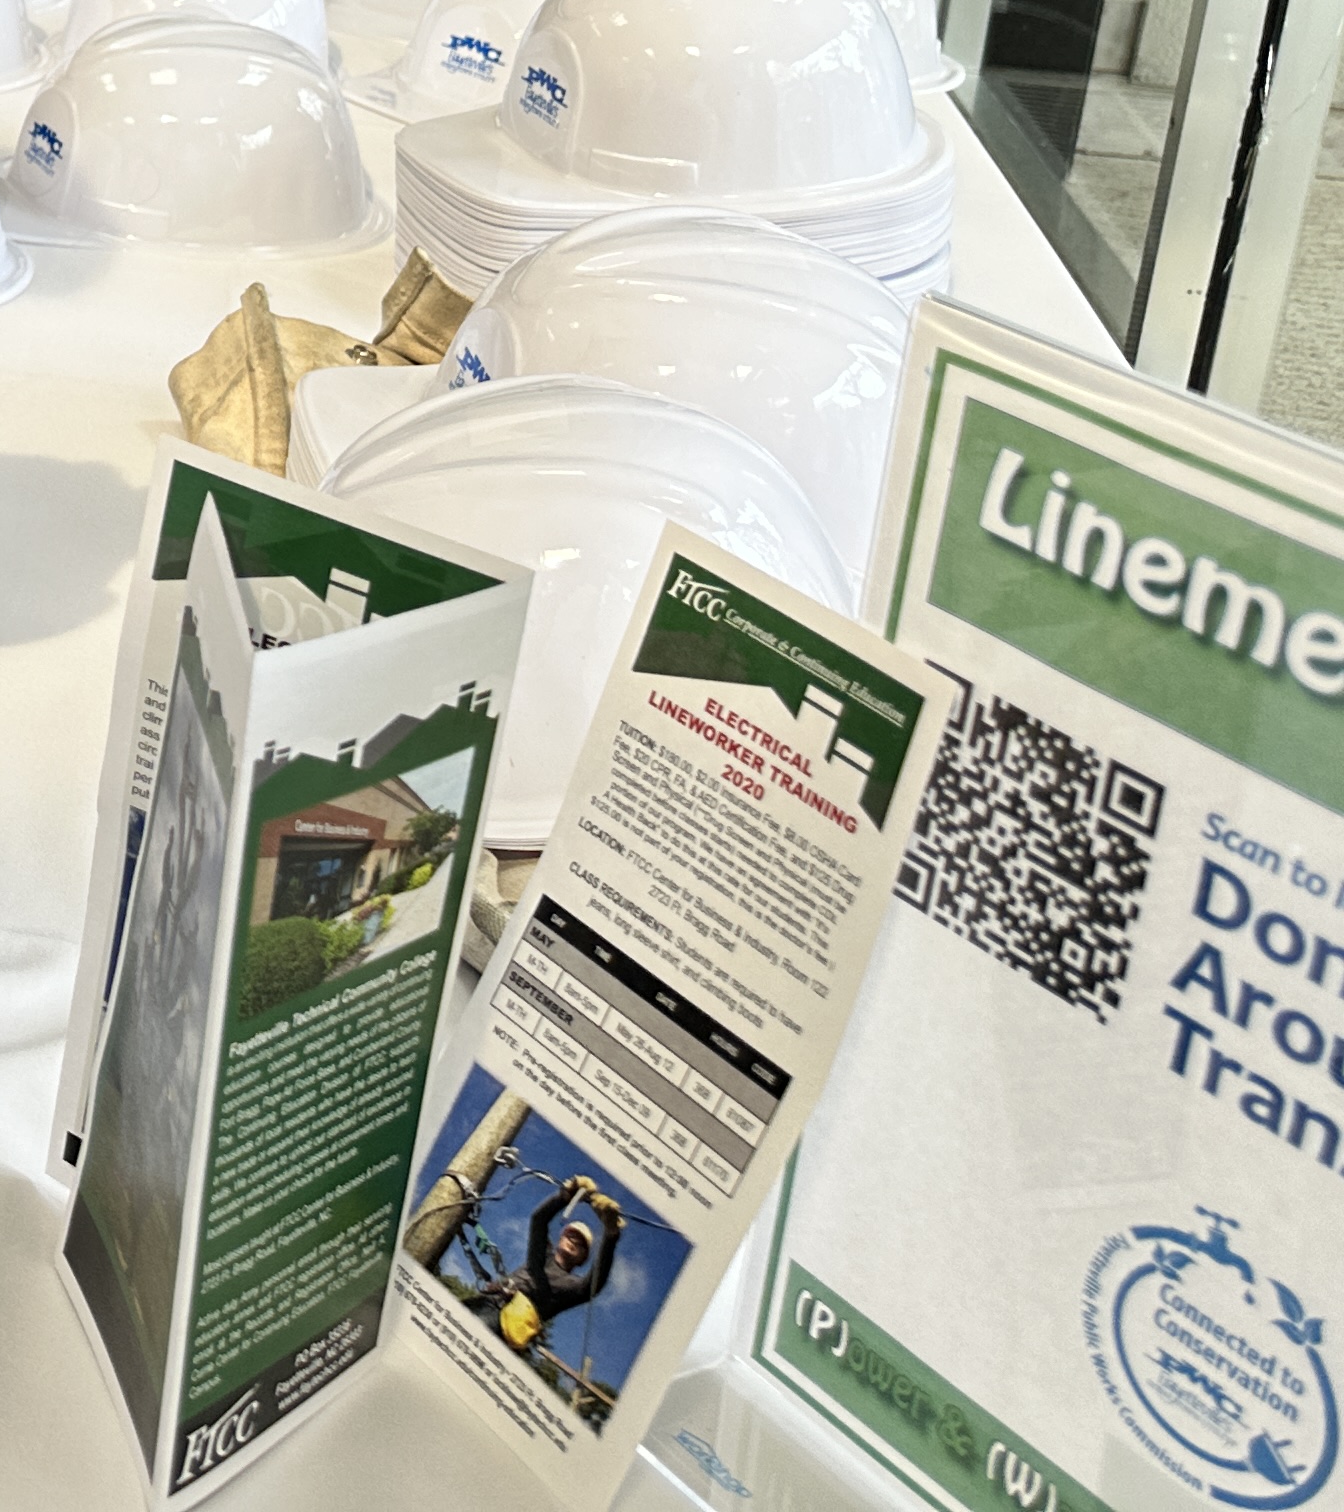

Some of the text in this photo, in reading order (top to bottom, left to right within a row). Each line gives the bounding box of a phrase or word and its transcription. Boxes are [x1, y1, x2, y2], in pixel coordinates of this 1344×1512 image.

[980, 447, 1344, 694] Lineme
[667, 568, 729, 623] FTCC
[724, 607, 778, 644] Corporate
[790, 644, 851, 692] Continuing
[848, 680, 906, 722] Education
[144, 695, 166, 712] and
[617, 719, 658, 753] TUITION:
[703, 696, 816, 777] ELECTRICAL
[647, 689, 859, 834] LINEWORKER TRAINING
[720, 763, 765, 802] 2020
[789, 850, 808, 871] and
[1202, 812, 1328, 898] Scan to
[529, 925, 554, 951] MAY
[568, 859, 600, 890] CLASS
[598, 881, 675, 944] REQUIREMENTS:
[674, 935, 713, 972] Students
[577, 815, 627, 857] LOCATION:
[625, 849, 652, 875] FTCC
[651, 866, 681, 895] Center
[680, 887, 694, 904] for
[693, 896, 734, 932] Business
[779, 956, 809, 985] Room
[682, 909, 711, 937] Bragg
[709, 928, 736, 955] Road
[399, 949, 438, 979] College
[586, 893, 613, 921] jeans,
[611, 911, 632, 936] long
[630, 925, 660, 956] sleeve
[680, 961, 700, 985] and
[698, 975, 738, 1013] climbing
[508, 969, 574, 1027] SEPTEMBER
[491, 1024, 519, 1053] NOTE:
[520, 1047, 585, 1107] Pre-registration
[538, 1078, 555, 1098] day
[554, 1091, 583, 1121] before
[615, 1141, 640, 1168] class
[1081, 1299, 1100, 1349] Public
[1153, 1308, 1300, 1422] Conservation
[1159, 1283, 1306, 1397] Connected to
[1090, 1353, 1122, 1405] Works
[176, 1384, 260, 1485] FTCC
[1118, 1407, 1204, 1491] Commission
